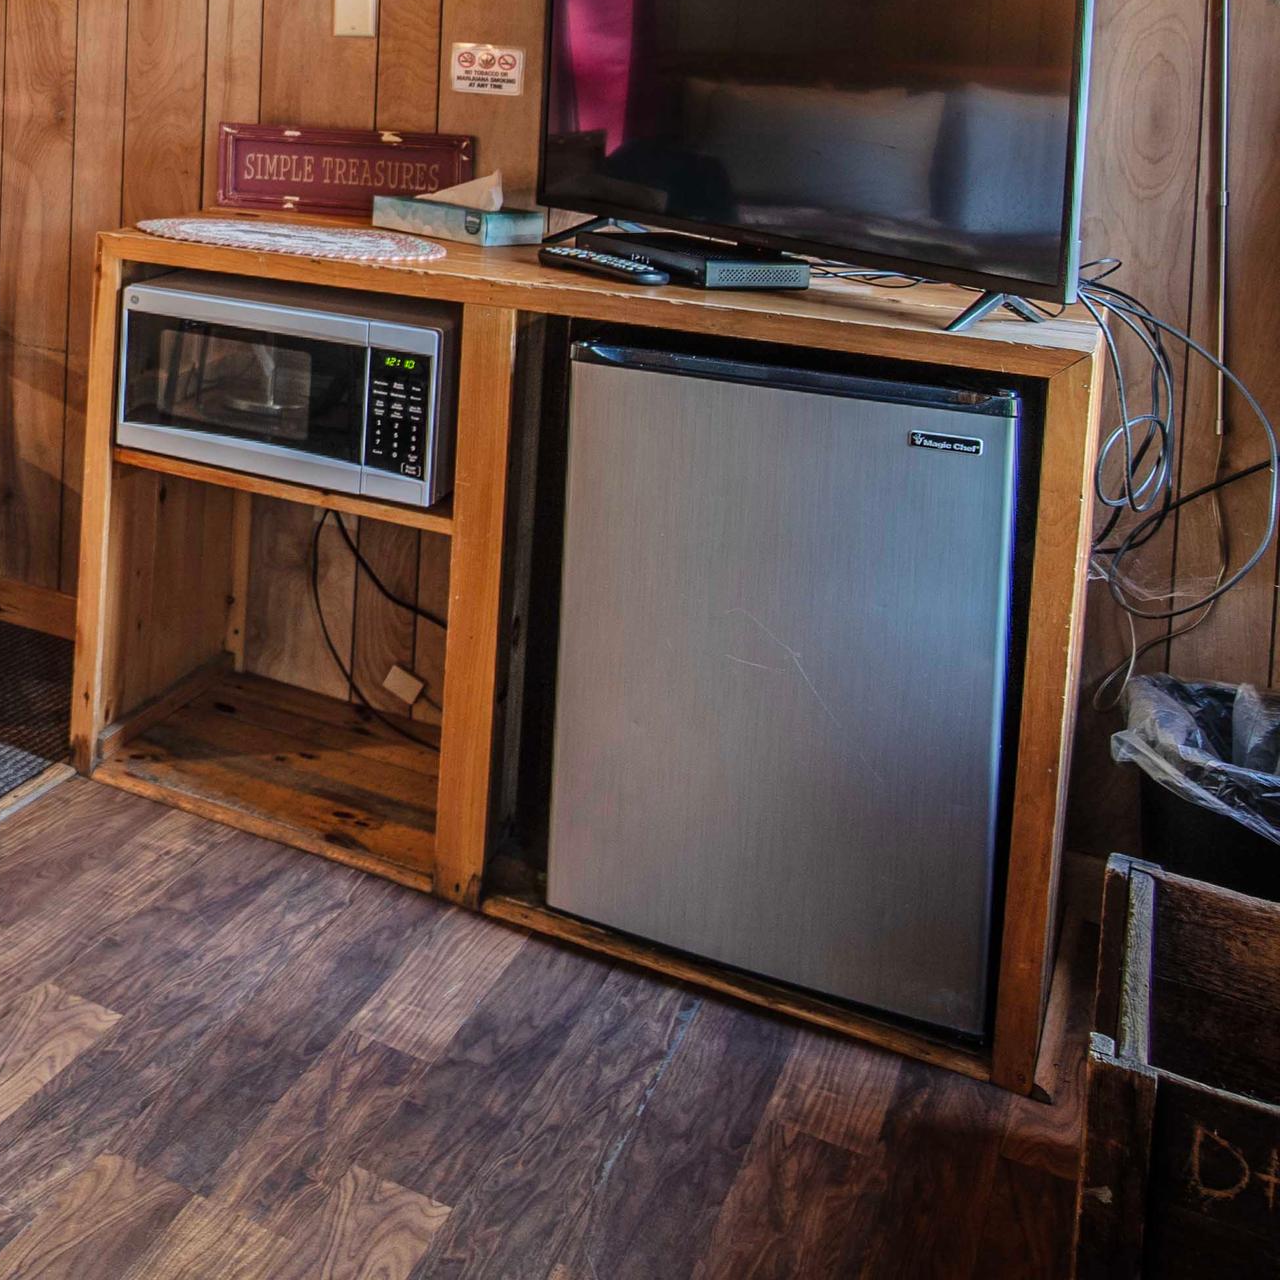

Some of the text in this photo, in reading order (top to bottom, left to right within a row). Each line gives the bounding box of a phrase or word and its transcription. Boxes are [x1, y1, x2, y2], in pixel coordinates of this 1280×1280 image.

[244, 153, 440, 191] SIMPLE TREASURES
[385, 357, 416, 370] 12:10
[923, 439, 976, 452] Magic Chef
